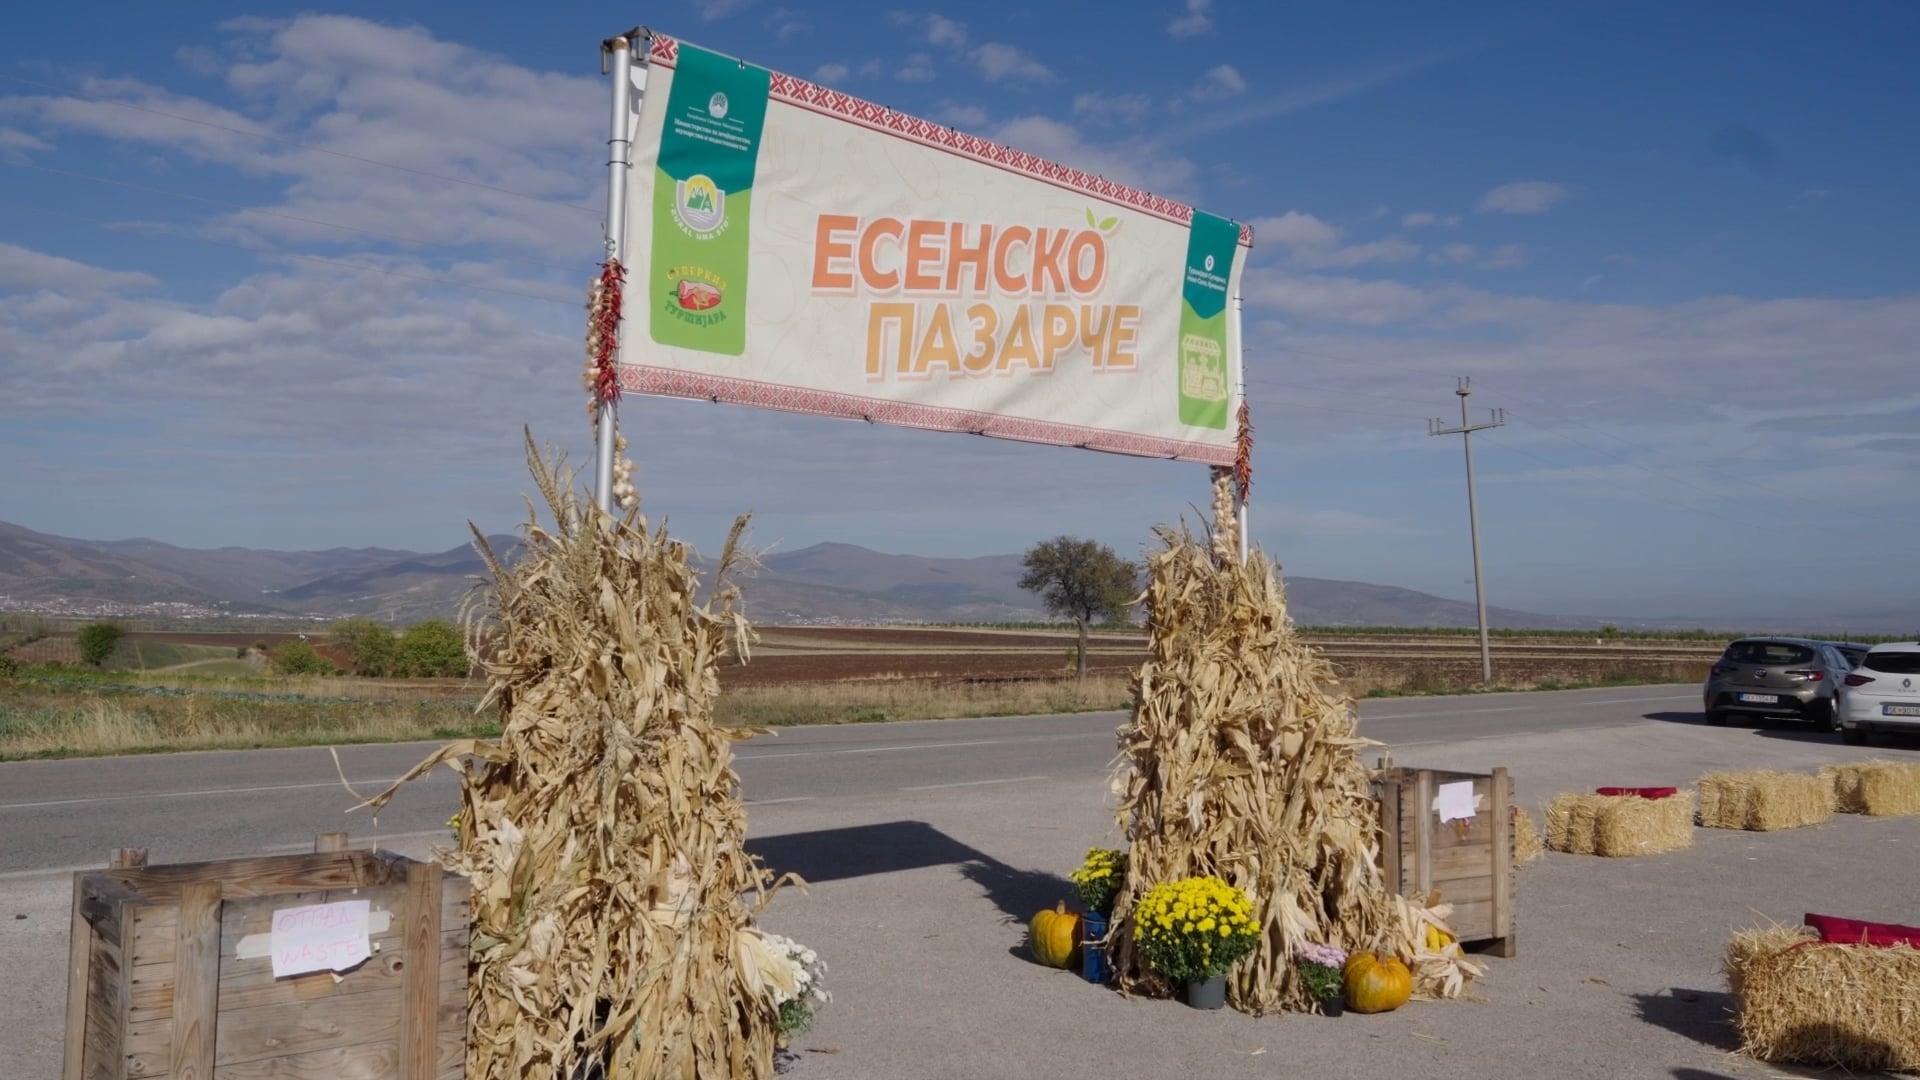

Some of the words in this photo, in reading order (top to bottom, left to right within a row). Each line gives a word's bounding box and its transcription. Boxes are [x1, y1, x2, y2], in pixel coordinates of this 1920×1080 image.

[811, 213, 1107, 296] ЕСЕНСКО
[864, 302, 1141, 378] ПАЗАРЧЕ
[280, 938, 358, 966] WASTE
